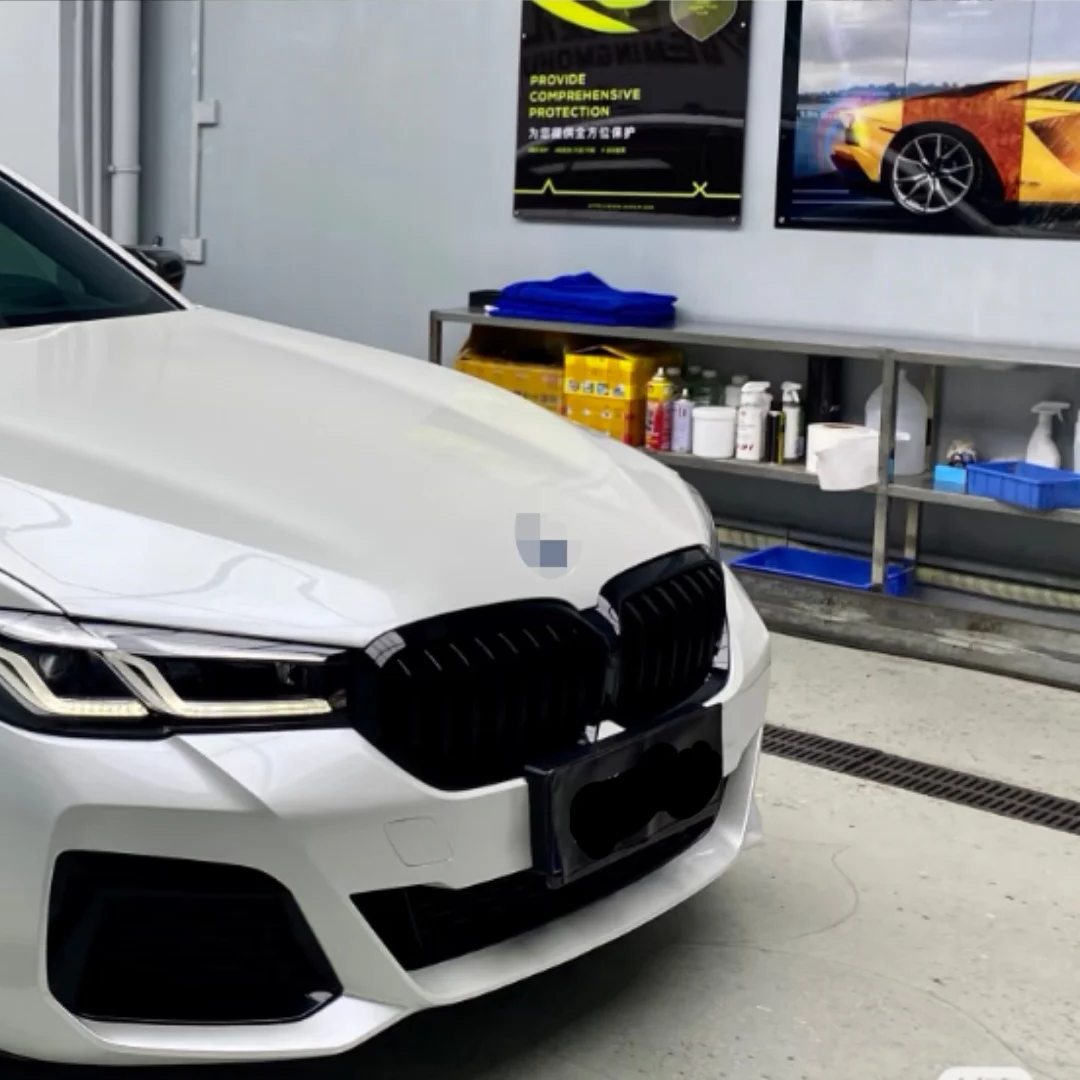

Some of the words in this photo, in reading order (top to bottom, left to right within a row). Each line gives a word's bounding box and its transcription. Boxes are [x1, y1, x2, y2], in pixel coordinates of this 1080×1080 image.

[529, 74, 586, 86] PROVIDE
[529, 88, 641, 102] COMPREHENSIVE
[528, 106, 610, 118] PROTECTION
